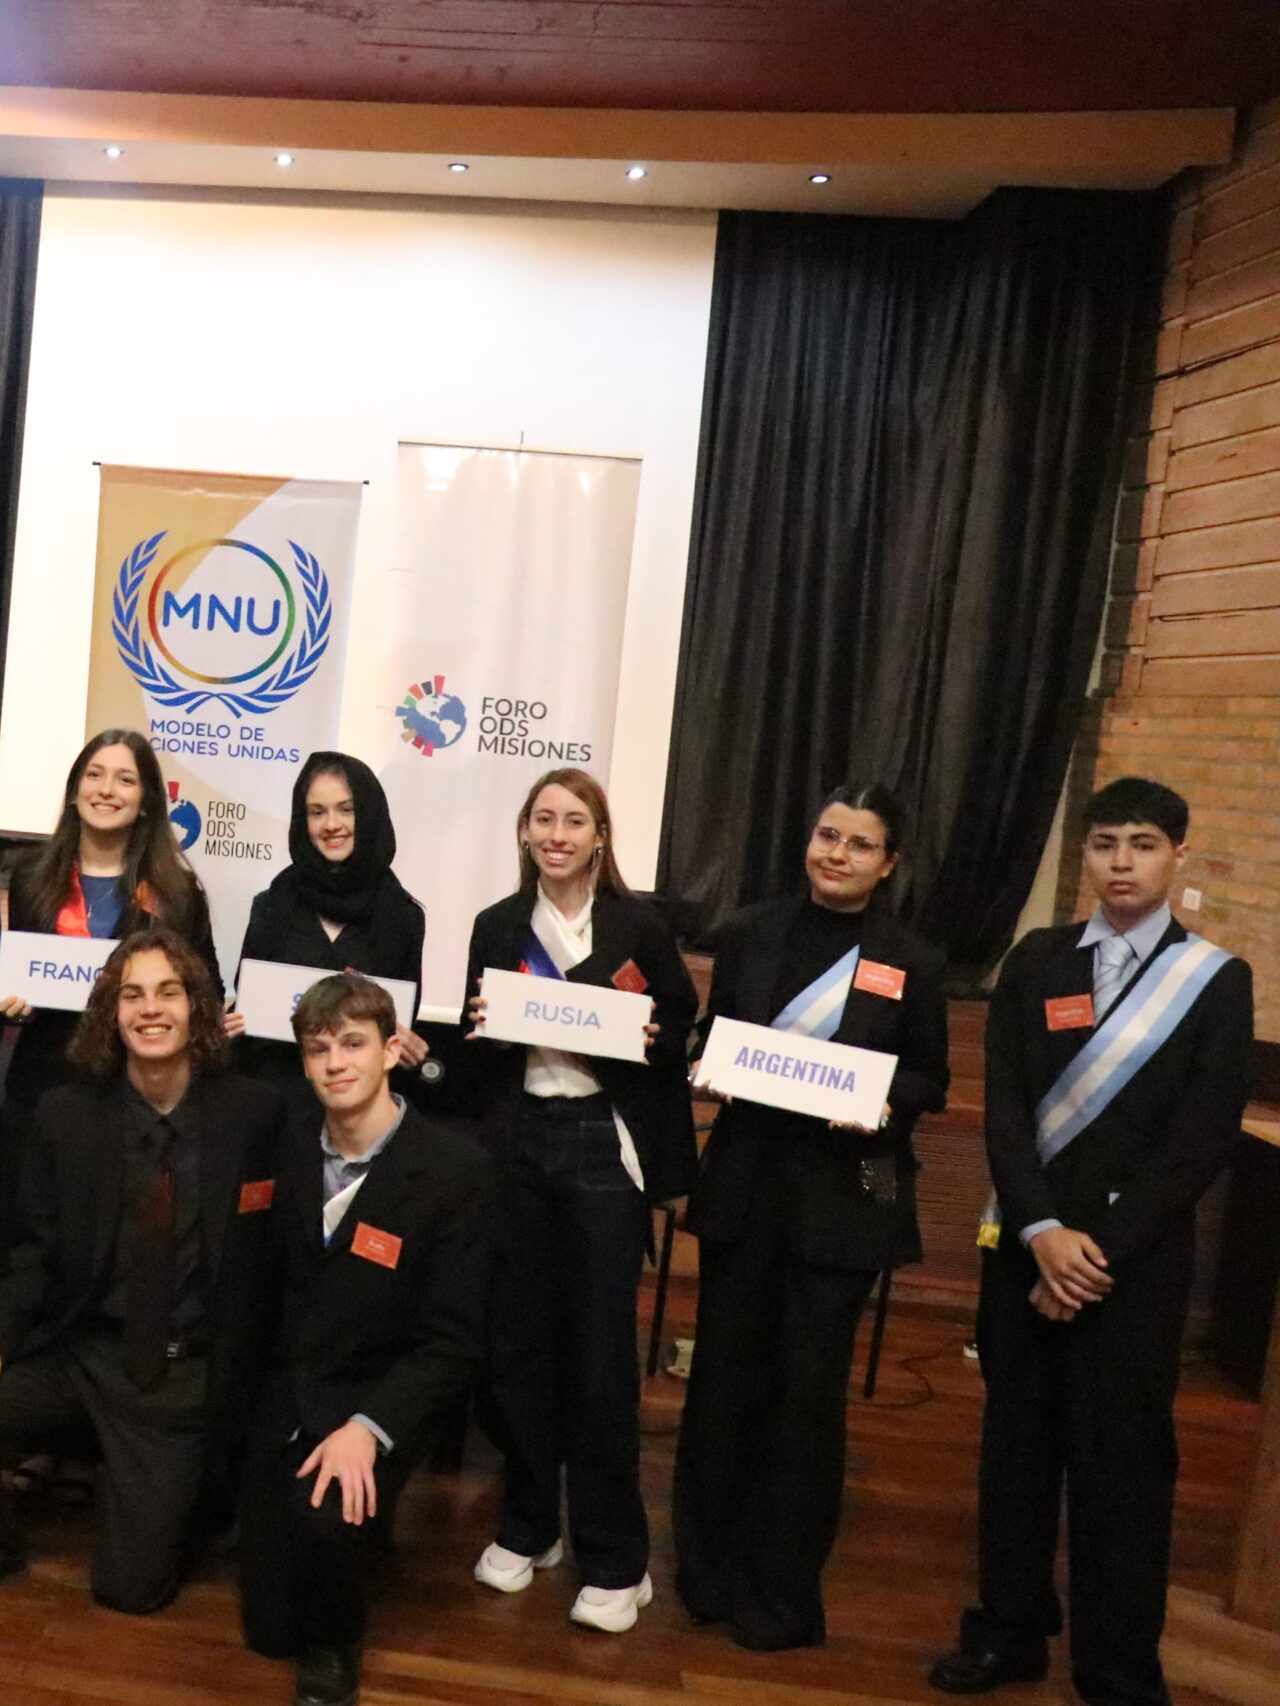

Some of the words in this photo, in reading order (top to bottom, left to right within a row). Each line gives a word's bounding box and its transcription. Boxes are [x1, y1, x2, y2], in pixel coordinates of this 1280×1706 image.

[162, 590, 281, 636] MNU
[481, 697, 548, 719] FORO
[150, 719, 231, 739] MODELO
[239, 726, 265, 741] DE
[479, 716, 529, 737] ODS
[227, 744, 300, 763] UNIDAS
[477, 735, 592, 762] MISIONES
[207, 801, 246, 820] FORO
[206, 820, 236, 838] ODS
[204, 839, 273, 860] MISIONES
[524, 1000, 602, 1030] RUSIA
[734, 1044, 857, 1093] ARGENTINA
